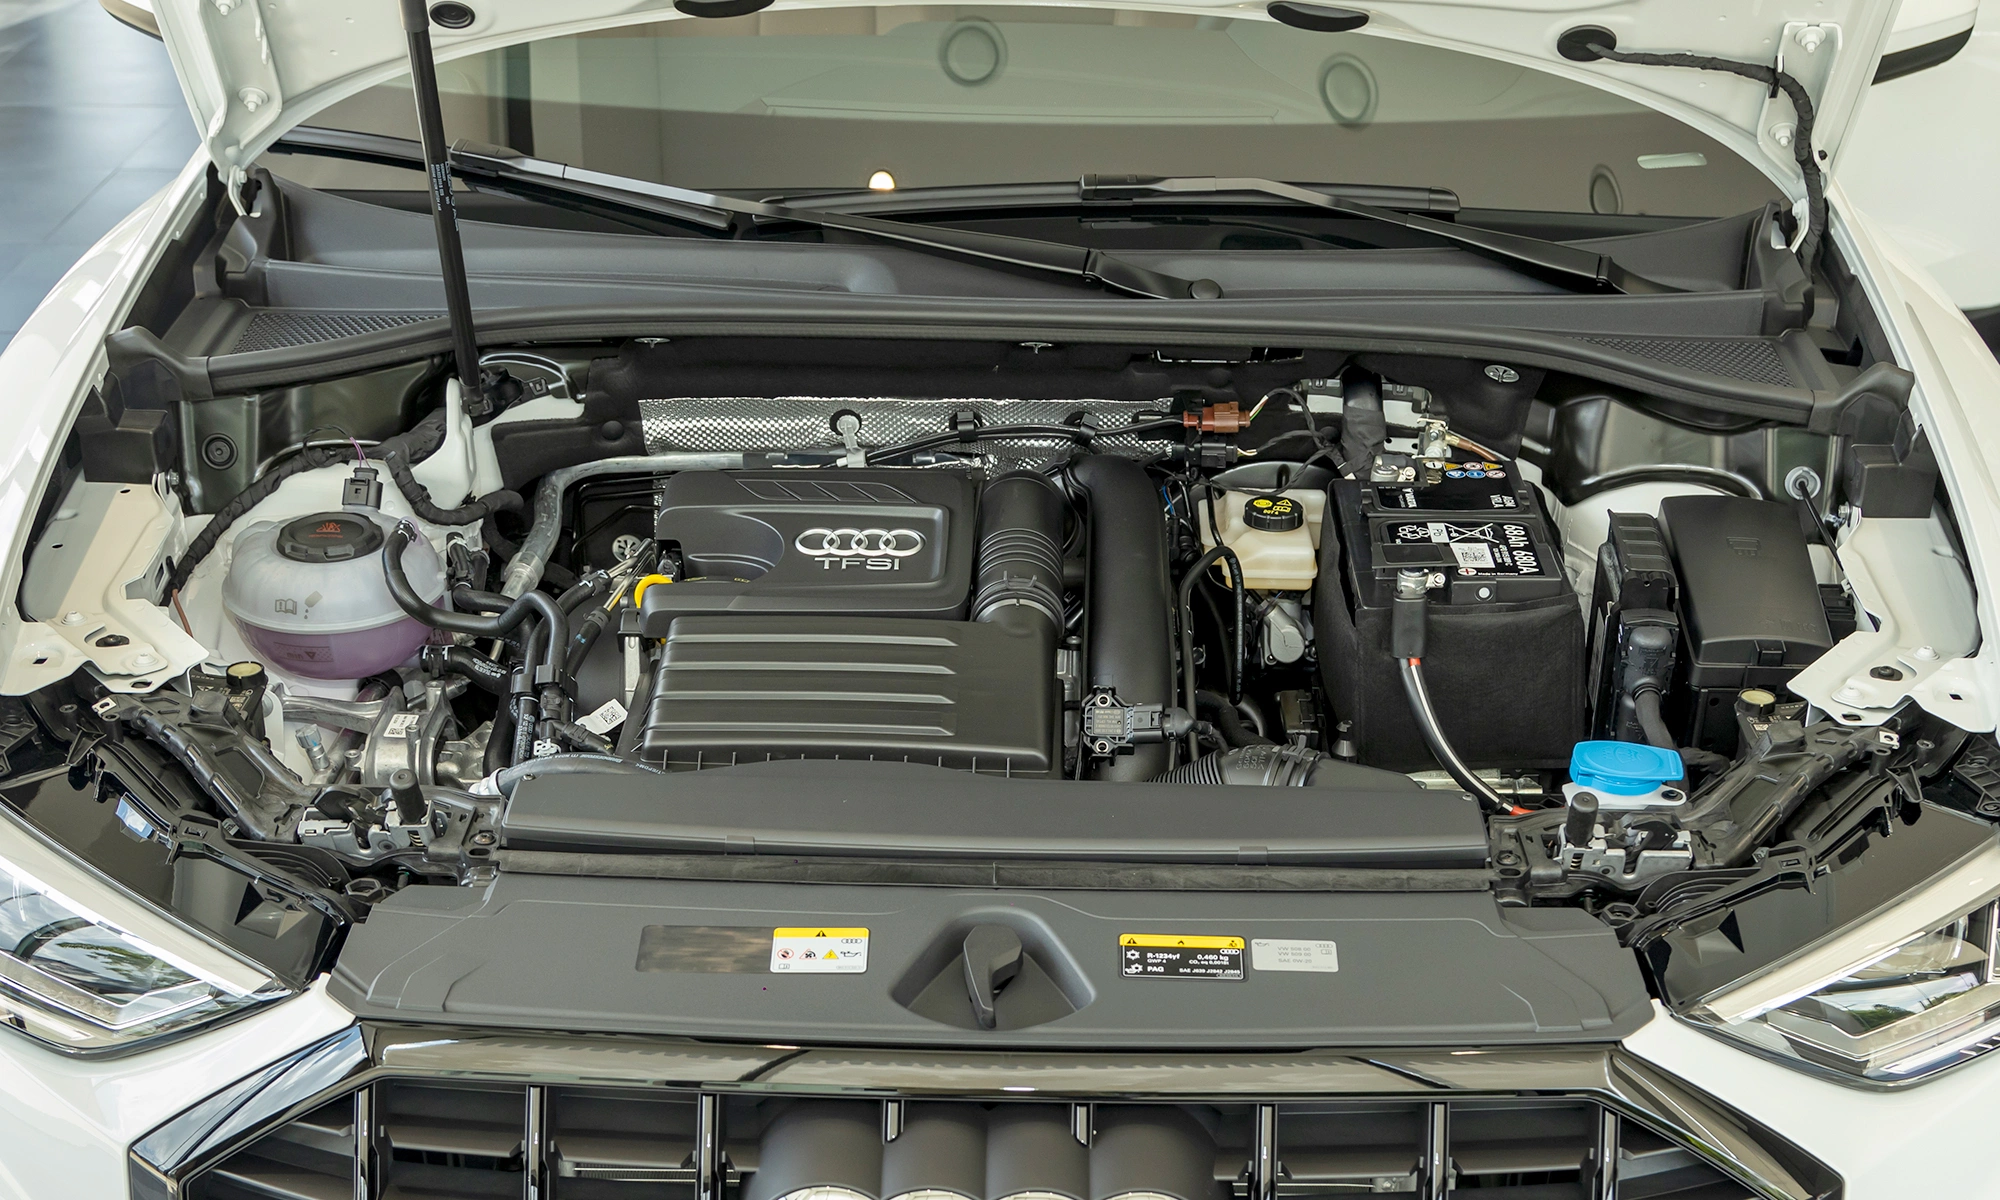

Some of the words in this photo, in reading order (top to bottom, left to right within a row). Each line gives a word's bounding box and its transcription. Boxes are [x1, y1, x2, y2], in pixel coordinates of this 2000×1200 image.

[1490, 494, 1504, 508] VRLA
[1431, 528, 1443, 537] Pb
[1503, 524, 1530, 548] 68Ah
[814, 557, 900, 571] TFSI
[1512, 550, 1540, 574] 680A
[1146, 953, 1180, 961] R-1234yf
[1219, 954, 1229, 962] kg
